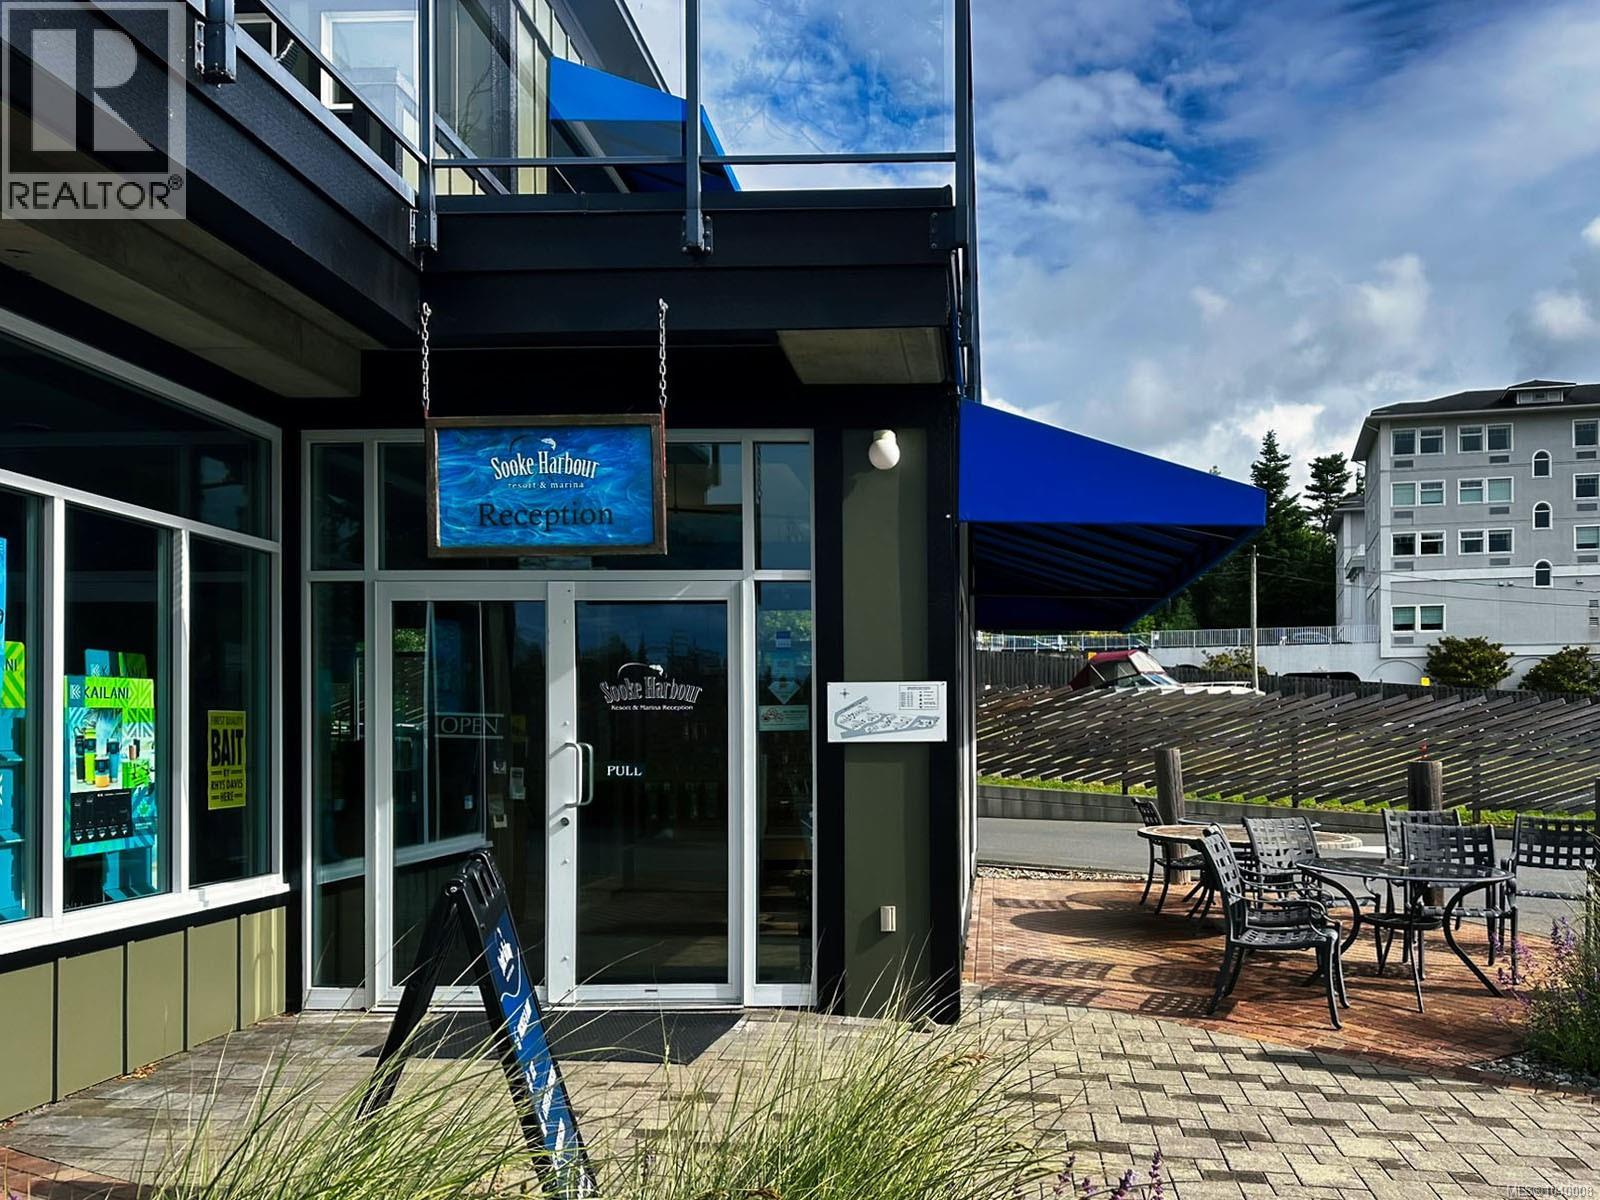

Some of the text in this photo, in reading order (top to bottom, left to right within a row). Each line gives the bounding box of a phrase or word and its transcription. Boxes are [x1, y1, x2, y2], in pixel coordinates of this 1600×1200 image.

[490, 450, 600, 480] Sooke Harbour
[539, 481, 546, 489] &
[478, 502, 613, 531] Reception
[84, 687, 129, 700] KAILANI
[600, 676, 703, 704] Sooke Harbour
[440, 717, 498, 734] OPEN
[211, 729, 244, 767] BAIT
[607, 765, 642, 776] PULL
